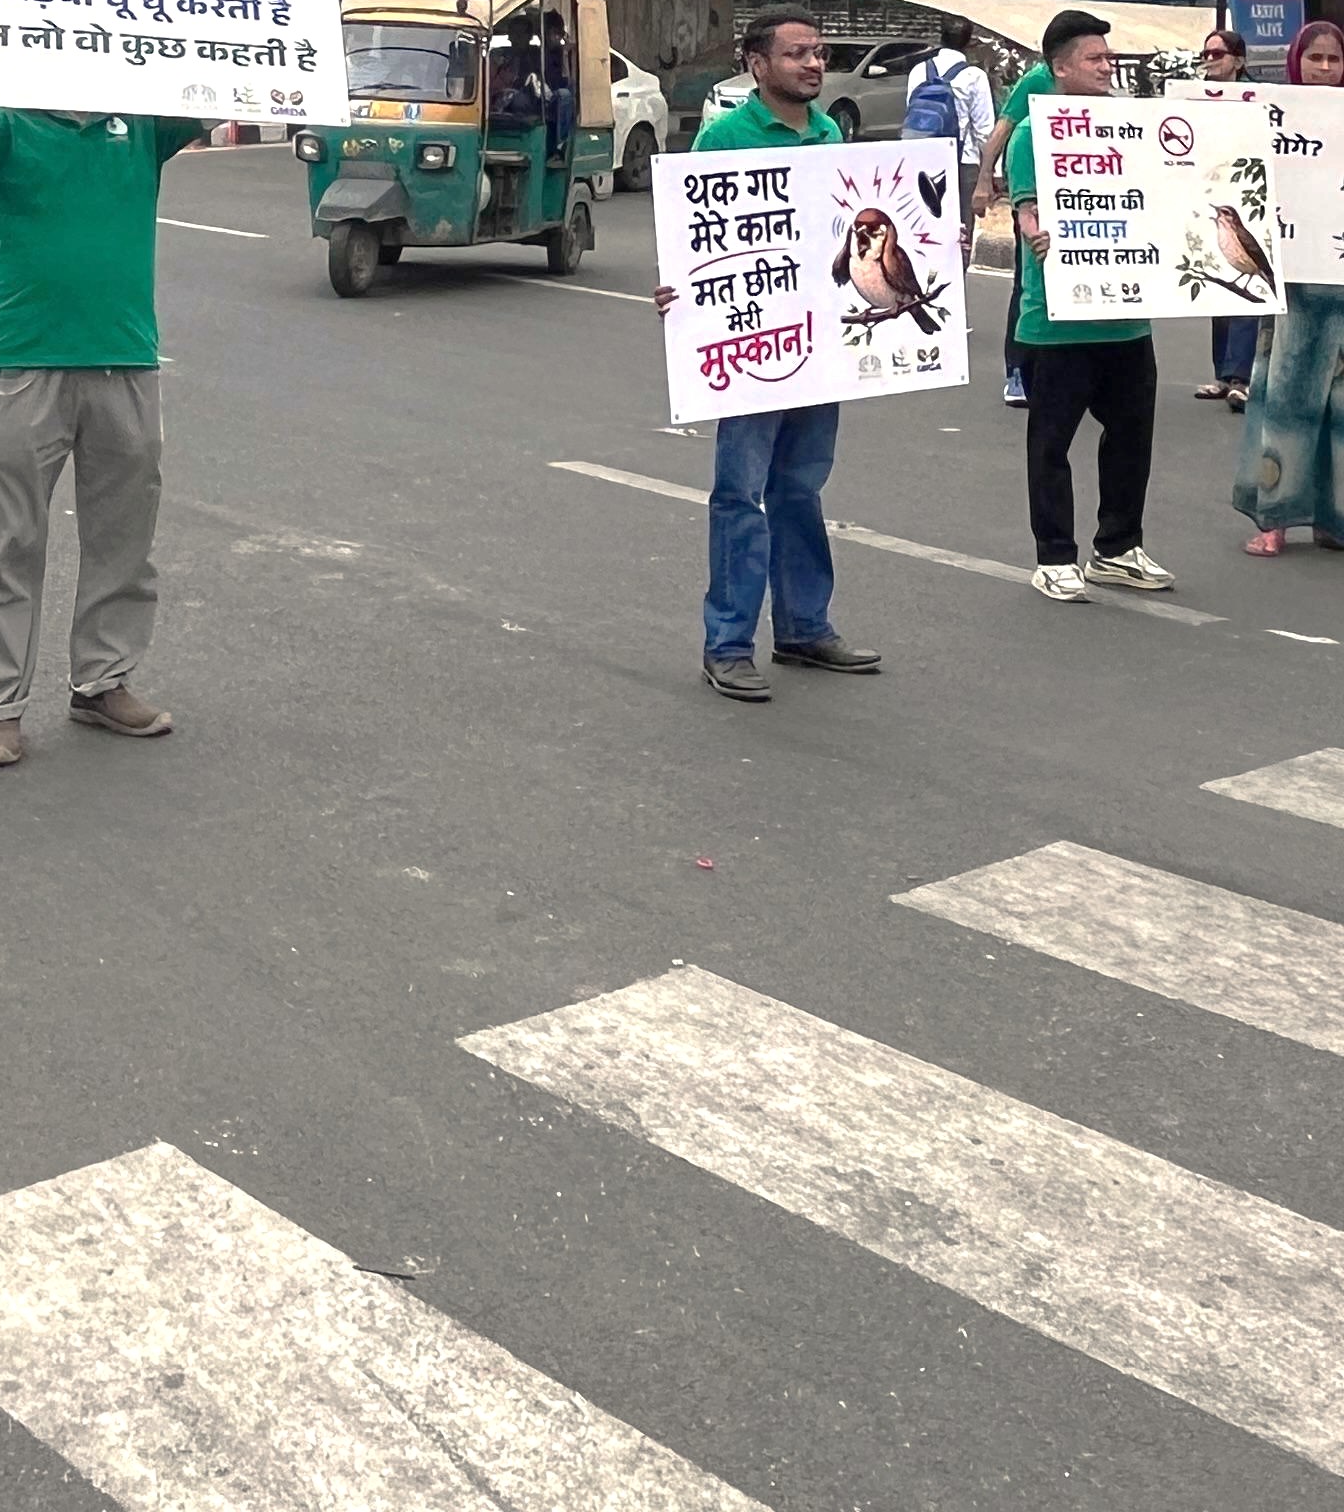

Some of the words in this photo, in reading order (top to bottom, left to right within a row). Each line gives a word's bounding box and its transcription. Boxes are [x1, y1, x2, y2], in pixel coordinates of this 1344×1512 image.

[19, 20, 65, 50] लो
[74, 24, 112, 53] वो
[120, 32, 186, 65] कुछ
[195, 38, 287, 67] कहती
[293, 40, 317, 71] है
[1047, 108, 1091, 140] हॉर्न
[1095, 126, 1113, 138] का
[1051, 146, 1123, 177] हटाओ
[684, 171, 738, 208] थक
[745, 166, 791, 203] गए
[1055, 188, 1117, 217] चिड़िया
[1120, 188, 1145, 211] की
[689, 210, 728, 253] मेरे
[735, 208, 800, 242] कान,
[1057, 218, 1127, 246] आवाज़
[1060, 247, 1110, 266] वापस
[1115, 242, 1159, 265] लाओ
[691, 274, 736, 307] मत
[743, 255, 800, 296] छीनो
[727, 301, 763, 332] मेरी
[697, 310, 813, 391] मुस्कान!
